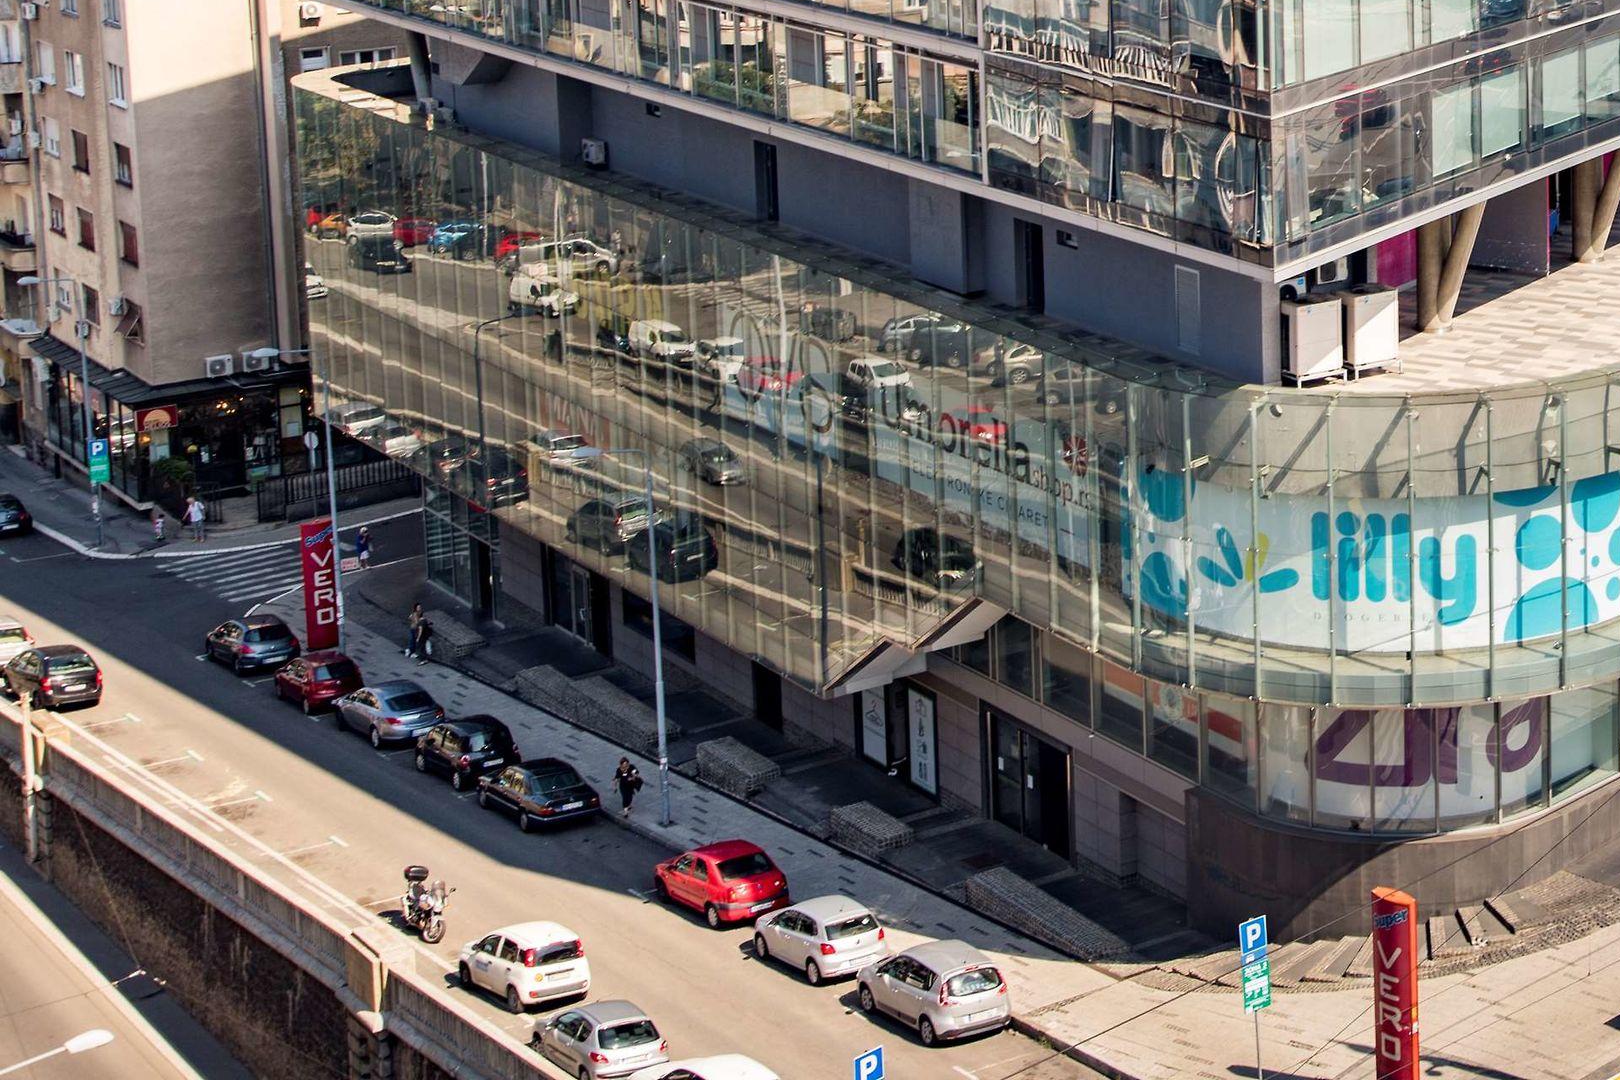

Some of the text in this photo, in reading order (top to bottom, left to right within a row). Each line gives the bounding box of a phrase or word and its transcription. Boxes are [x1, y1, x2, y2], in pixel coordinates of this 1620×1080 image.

[92, 442, 103, 455] P
[310, 548, 335, 626] VERO
[1311, 510, 1478, 627] lilly
[1246, 922, 1261, 949] P
[1377, 940, 1402, 1061] VERO
[860, 1055, 878, 1080] P
